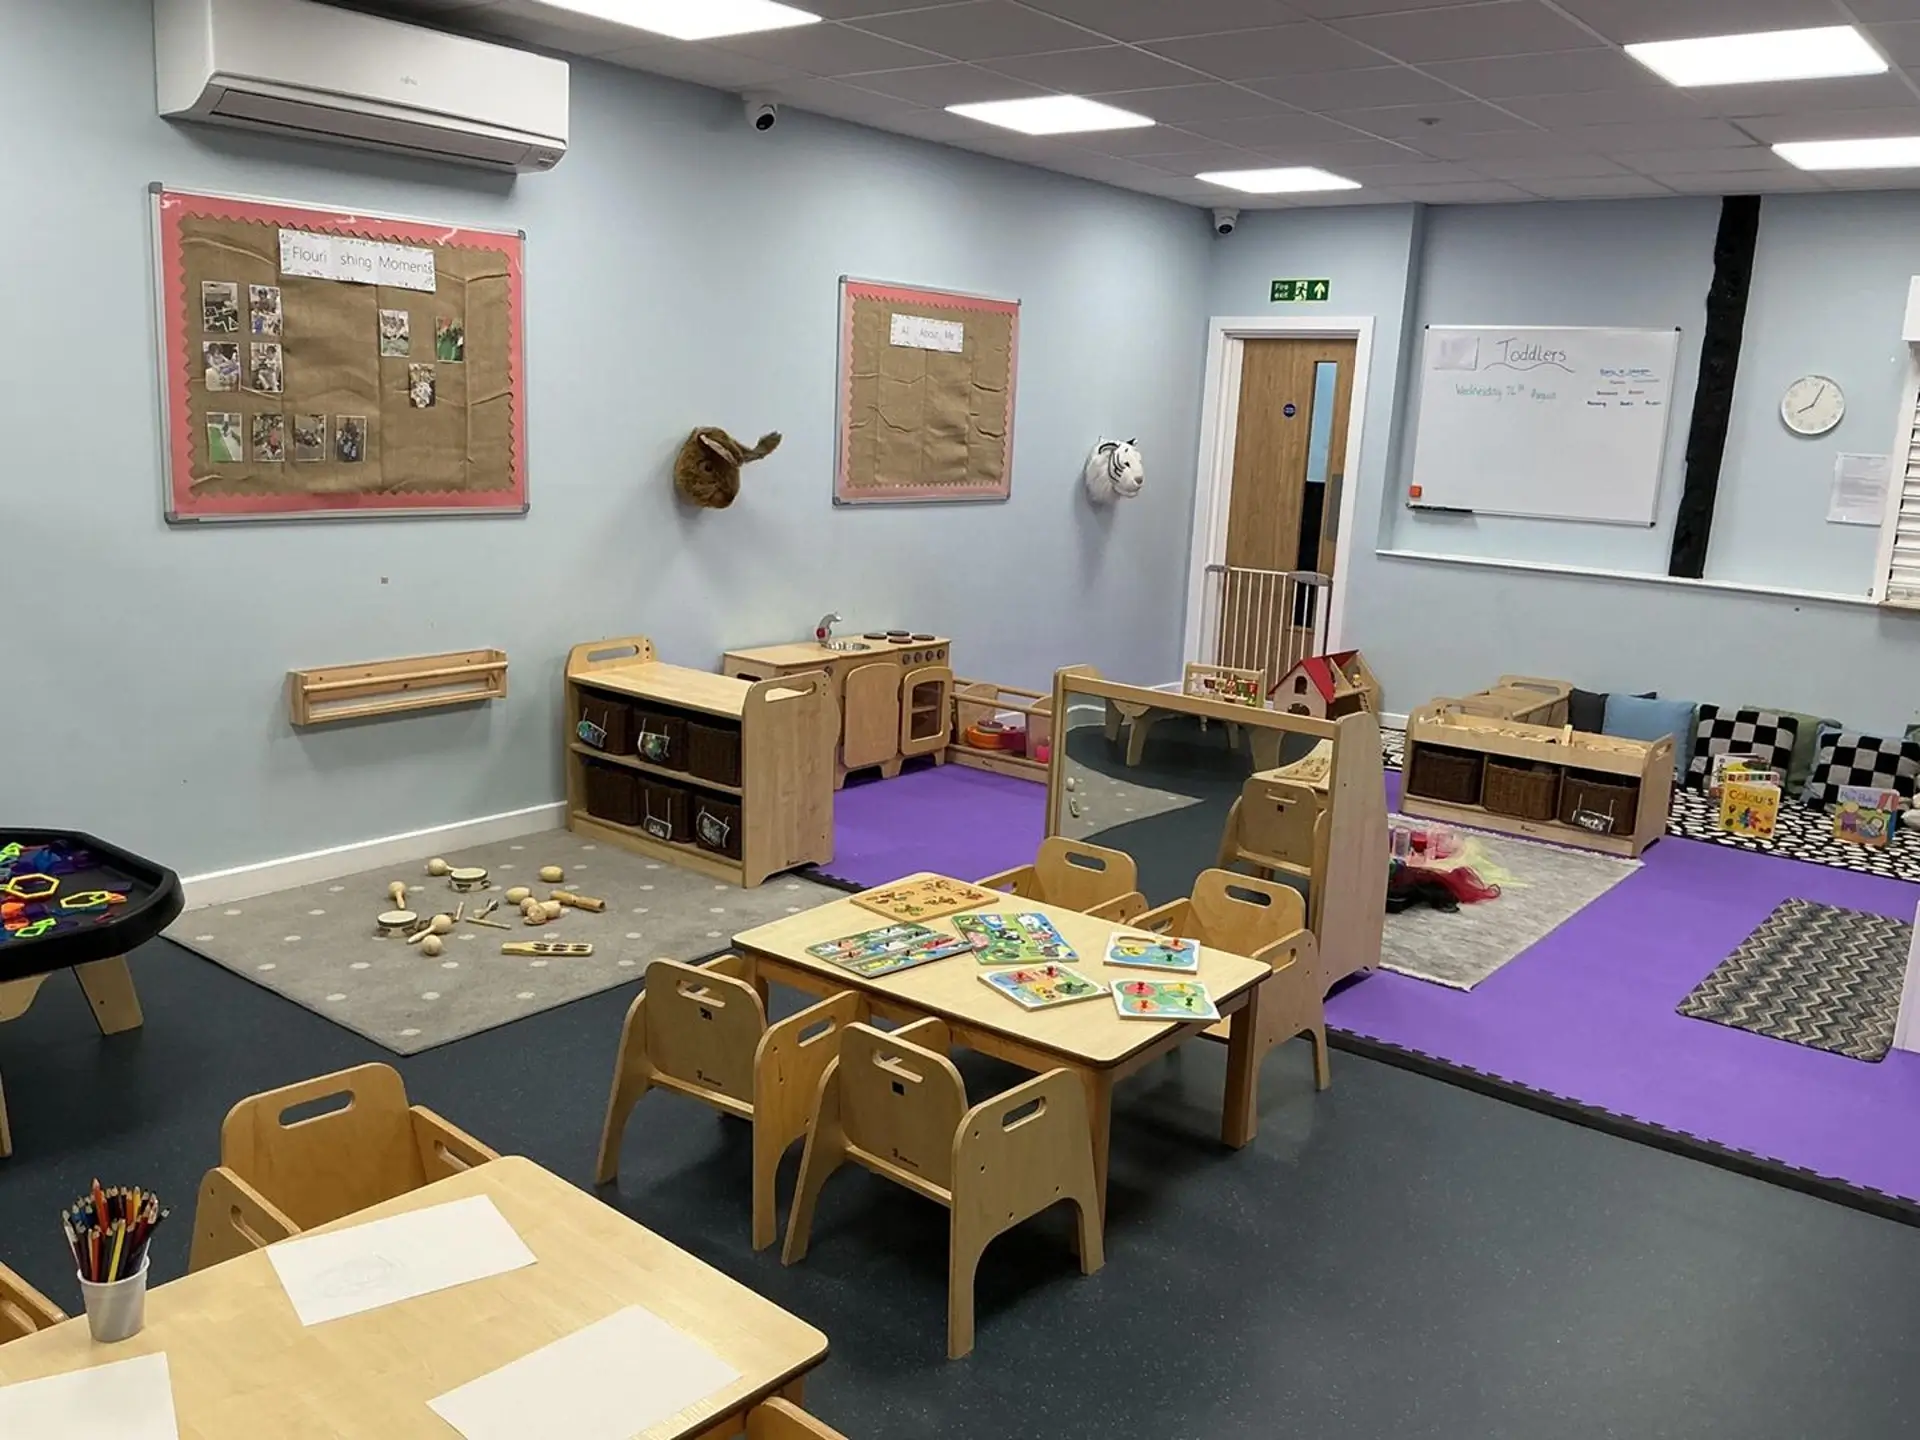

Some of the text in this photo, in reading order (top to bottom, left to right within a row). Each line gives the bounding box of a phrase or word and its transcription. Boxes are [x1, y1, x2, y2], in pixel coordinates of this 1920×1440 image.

[292, 246, 433, 274] Flouri shing Moments
[1496, 337, 1567, 362] Toddlers
[1728, 789, 1774, 806] Colours
